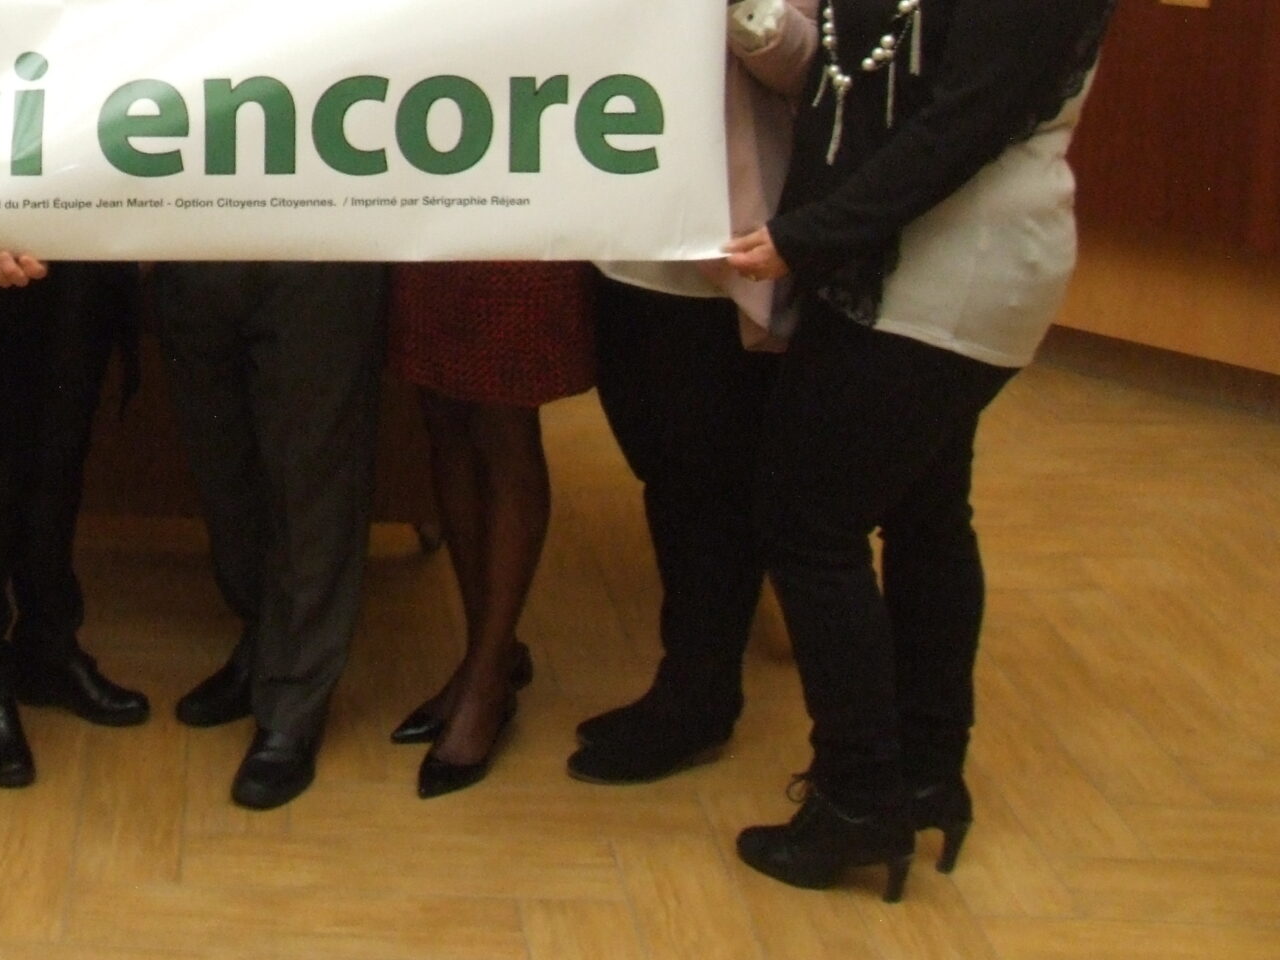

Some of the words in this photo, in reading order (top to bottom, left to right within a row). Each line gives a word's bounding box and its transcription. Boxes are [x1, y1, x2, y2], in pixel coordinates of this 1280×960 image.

[97, 73, 665, 178] encore
[4, 199, 19, 209] du
[22, 198, 50, 209] Parti
[53, 197, 92, 211] Équipe
[96, 198, 122, 208] Jean
[126, 197, 164, 208] Martel
[174, 198, 214, 210] Option
[217, 197, 267, 210] Citoyens
[270, 197, 337, 209] Citoyennes.
[350, 196, 397, 208] Imprimé
[400, 198, 419, 208] par
[422, 196, 487, 209] Sérigraphie
[490, 195, 530, 208] Réjean
